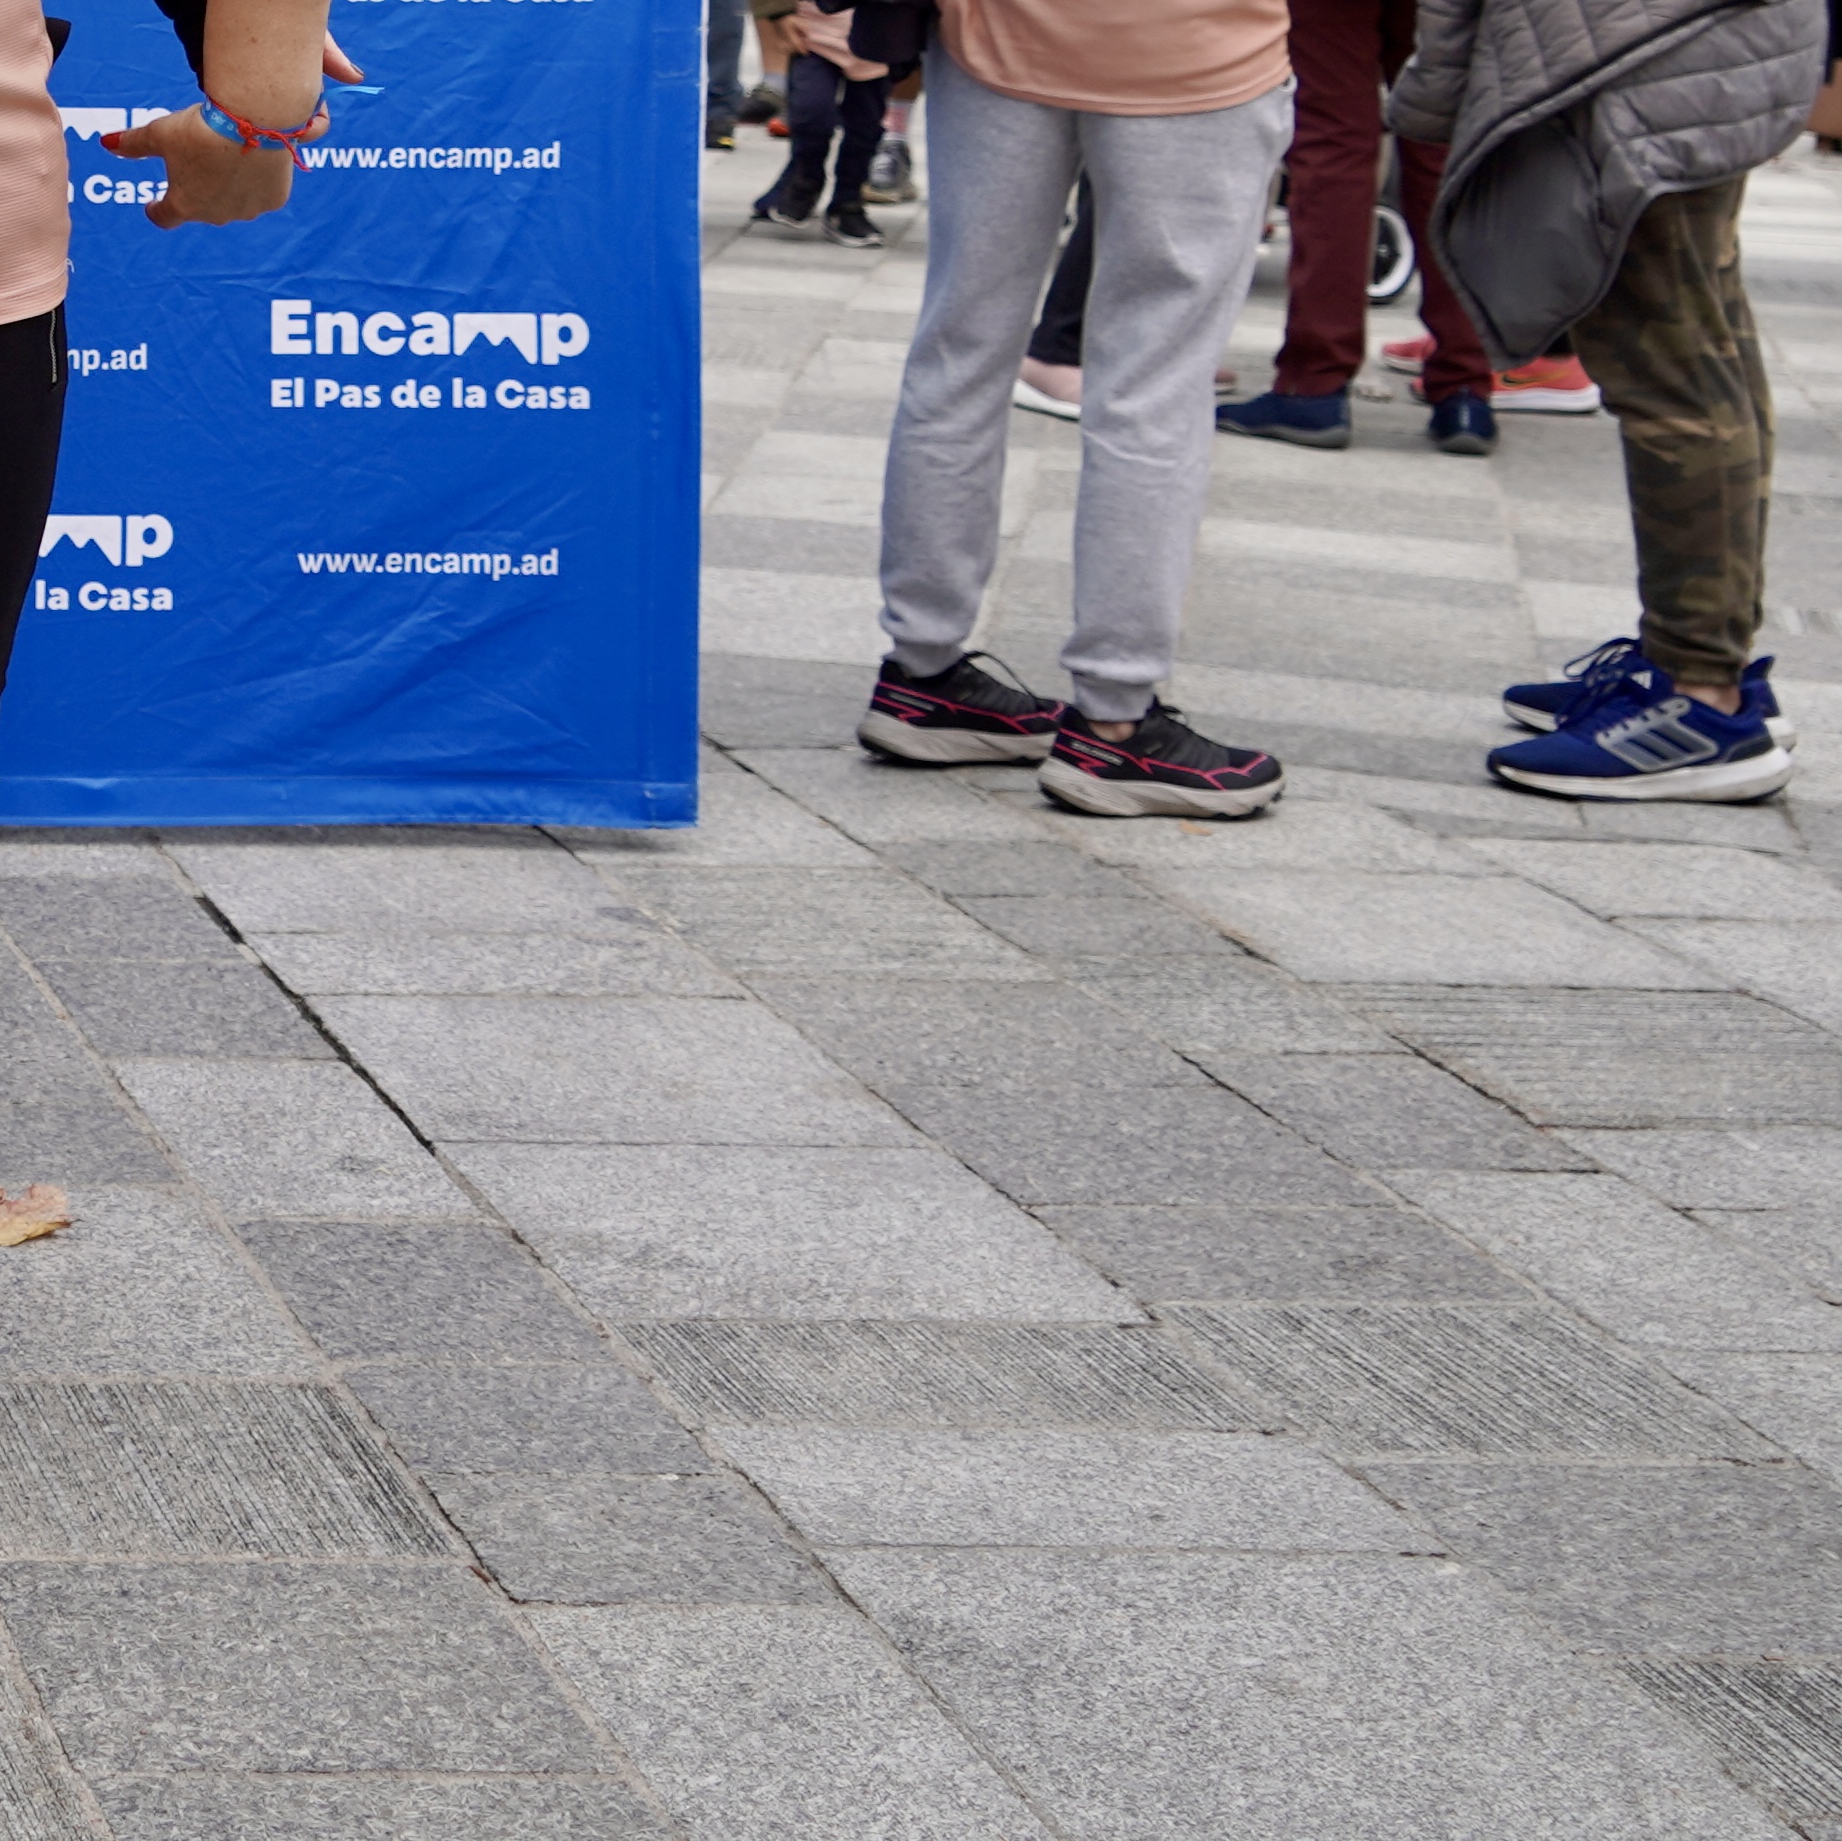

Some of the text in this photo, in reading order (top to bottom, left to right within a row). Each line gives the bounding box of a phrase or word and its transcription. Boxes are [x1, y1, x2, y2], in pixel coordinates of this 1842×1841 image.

[301, 141, 561, 175] www.encamp.ad
[270, 299, 590, 365] Encamp
[271, 377, 590, 410] El Pas de la Casa
[297, 548, 559, 581] www.encamp.ad
[35, 579, 173, 611] la Casa
